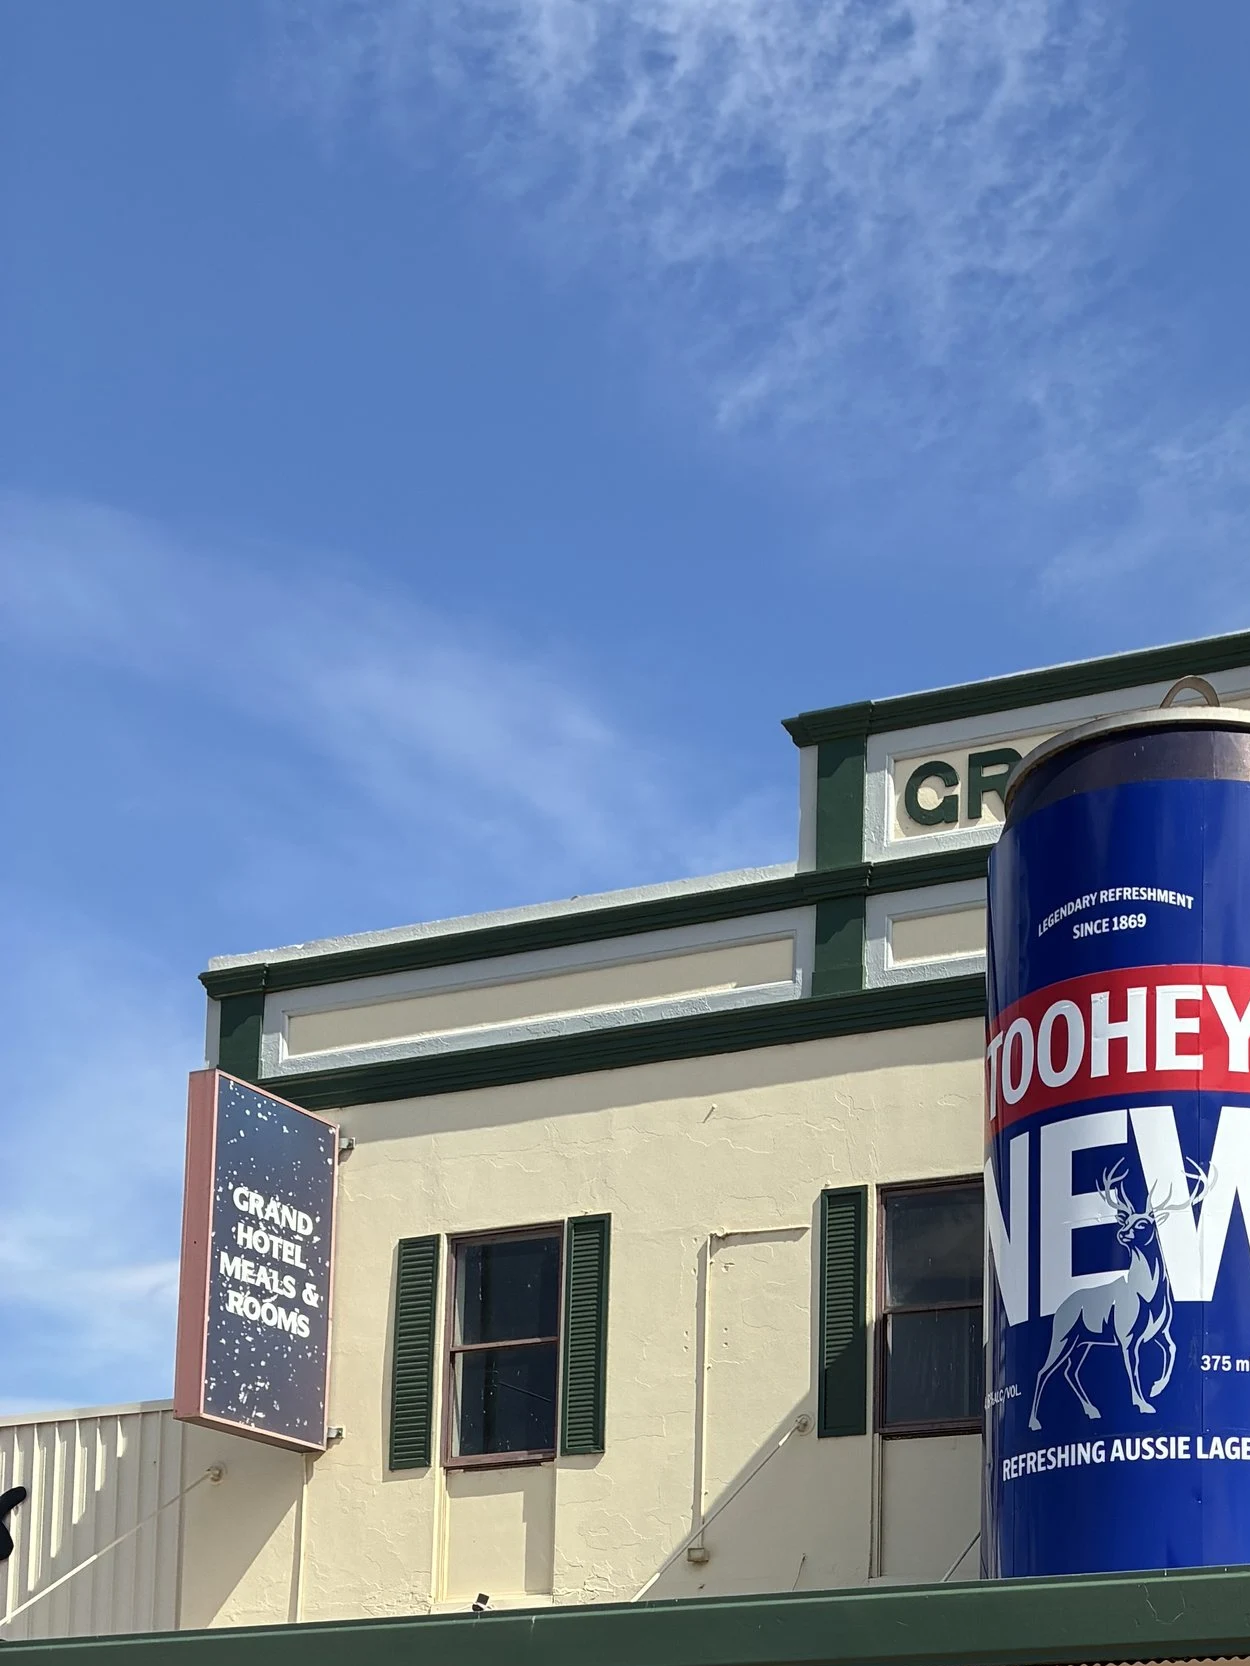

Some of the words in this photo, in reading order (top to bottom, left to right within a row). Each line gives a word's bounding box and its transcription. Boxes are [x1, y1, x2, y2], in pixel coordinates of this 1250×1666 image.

[1038, 890, 1098, 938] LEGENDARY
[1099, 887, 1194, 910] REFRESHMENT
[1072, 917, 1110, 940] SINCE
[1111, 914, 1147, 932] 1869
[233, 1186, 313, 1237] GRAND
[237, 1222, 307, 1270] HOTEL
[219, 1251, 297, 1300] MEALS
[301, 1282, 320, 1309] &
[225, 1290, 311, 1338] ROOMS
[1201, 1355, 1232, 1372] 375
[1002, 1440, 1106, 1482] REFRESHING
[1110, 1437, 1190, 1461] AUSSIE
